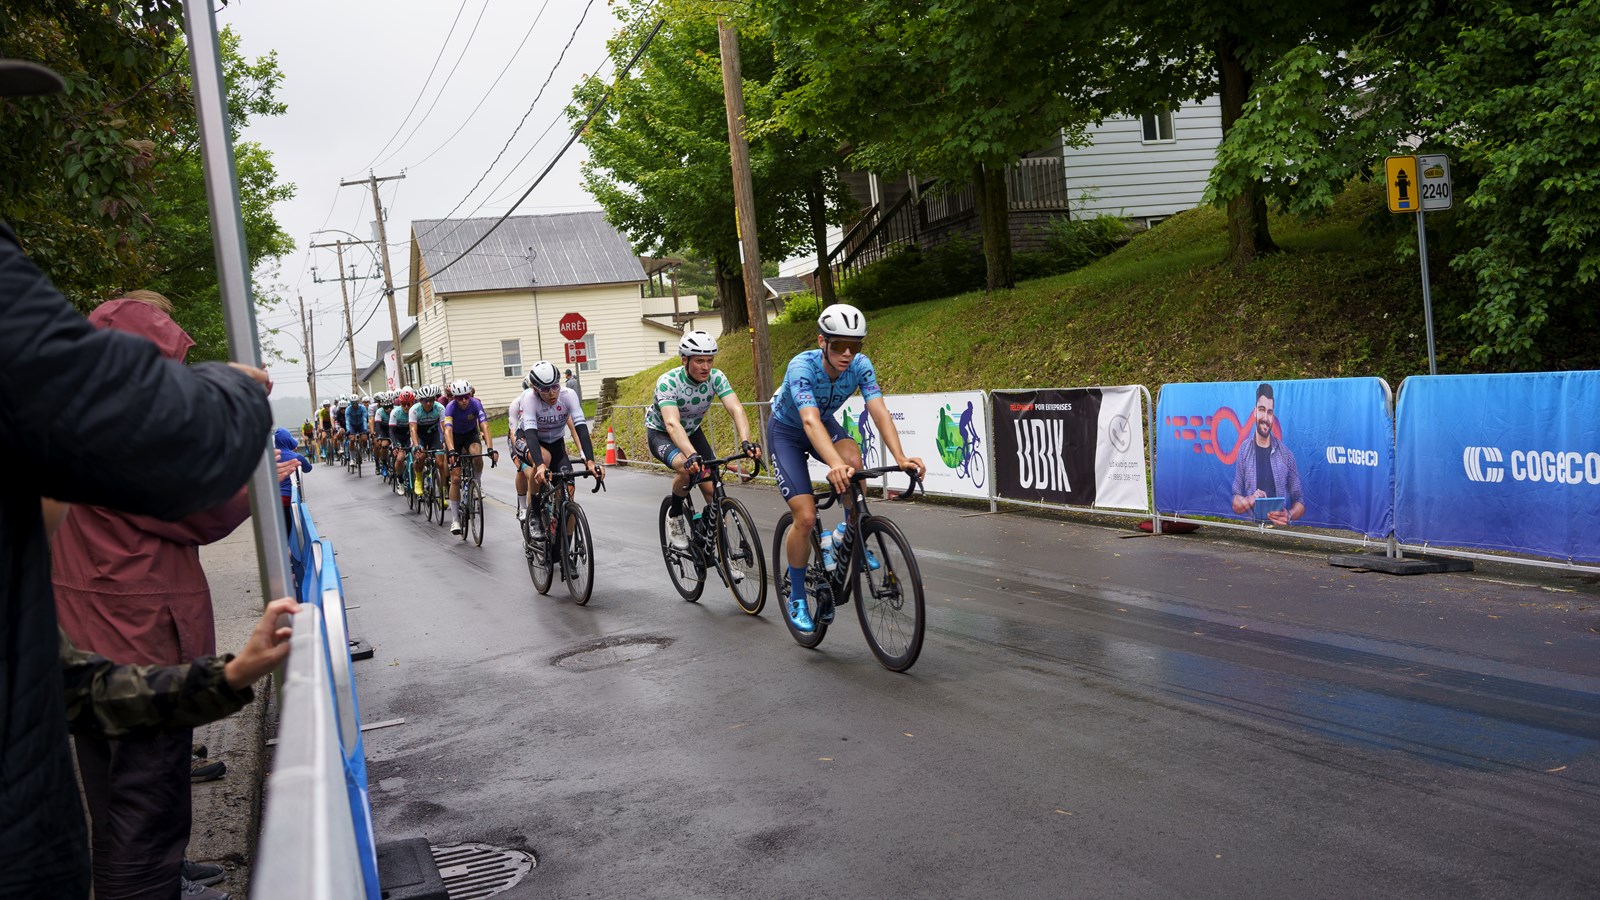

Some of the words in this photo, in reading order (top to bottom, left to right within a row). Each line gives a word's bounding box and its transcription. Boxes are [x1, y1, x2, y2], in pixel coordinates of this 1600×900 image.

[1423, 182, 1449, 199] 2240
[561, 320, 586, 331] ARRÊT
[1013, 419, 1072, 493] UBIK
